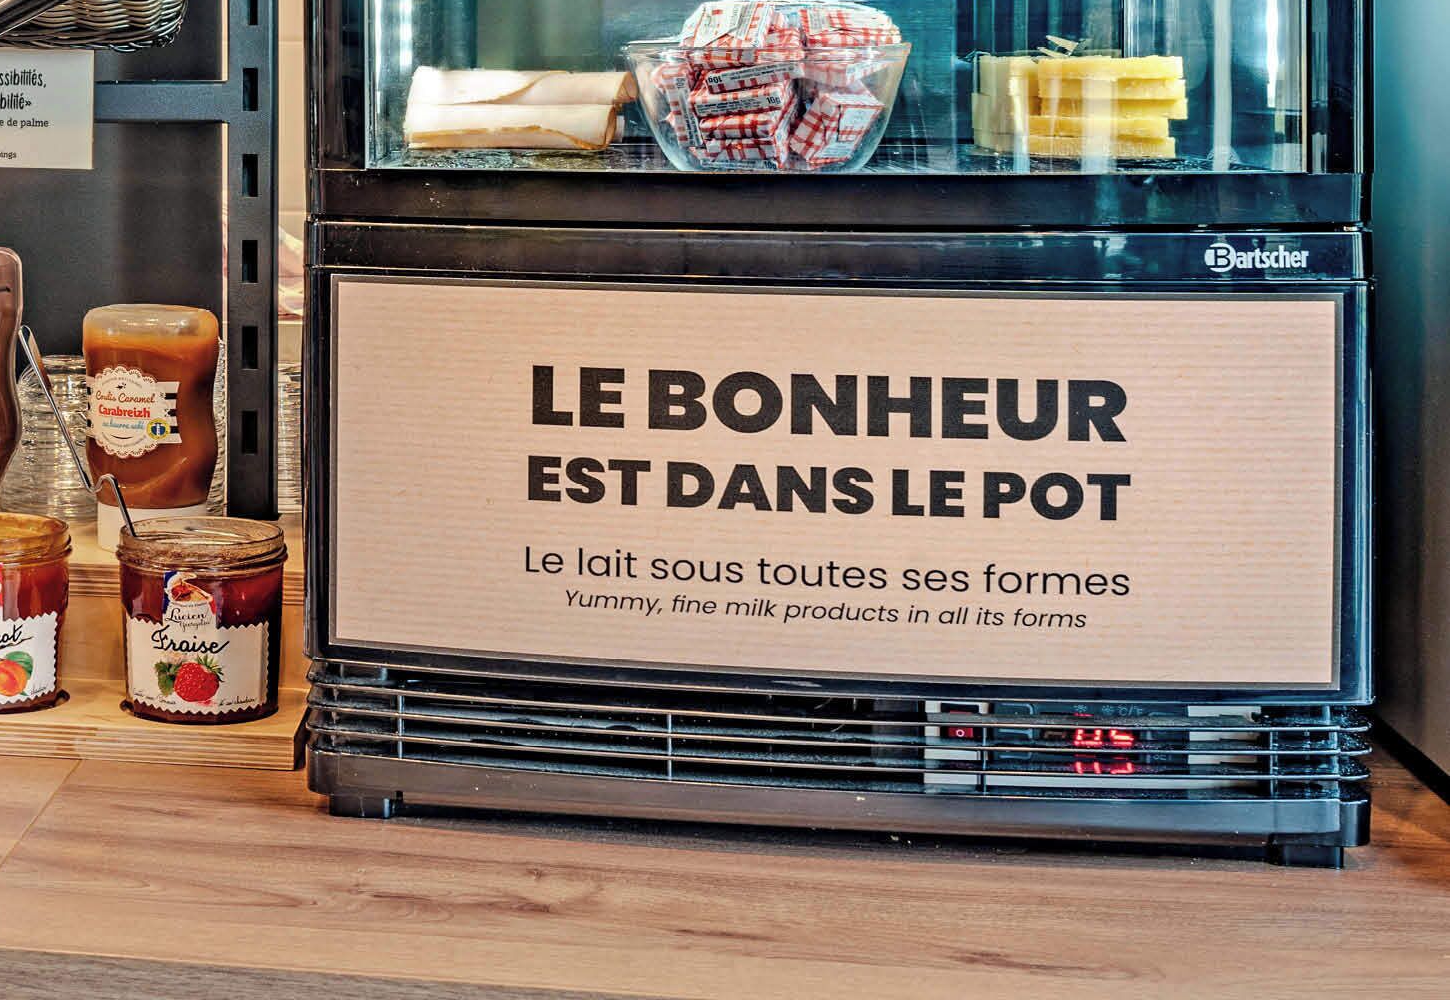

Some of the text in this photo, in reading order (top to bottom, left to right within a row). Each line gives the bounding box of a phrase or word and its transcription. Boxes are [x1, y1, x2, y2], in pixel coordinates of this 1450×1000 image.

[6, 117, 18, 127] de
[20, 118, 49, 130] palme
[1204, 242, 1310, 273] Bartscher
[98, 403, 151, 418] Carabreizh
[531, 364, 1128, 443] LE BONHEUR
[527, 455, 1131, 521] EST DANS LE POT
[525, 545, 1130, 596] Le lait sous toutes ses formes
[163, 607, 208, 624] Lucien
[565, 589, 1087, 628] Yummy, fine milk products in all its forms
[150, 624, 231, 655] Fraise
